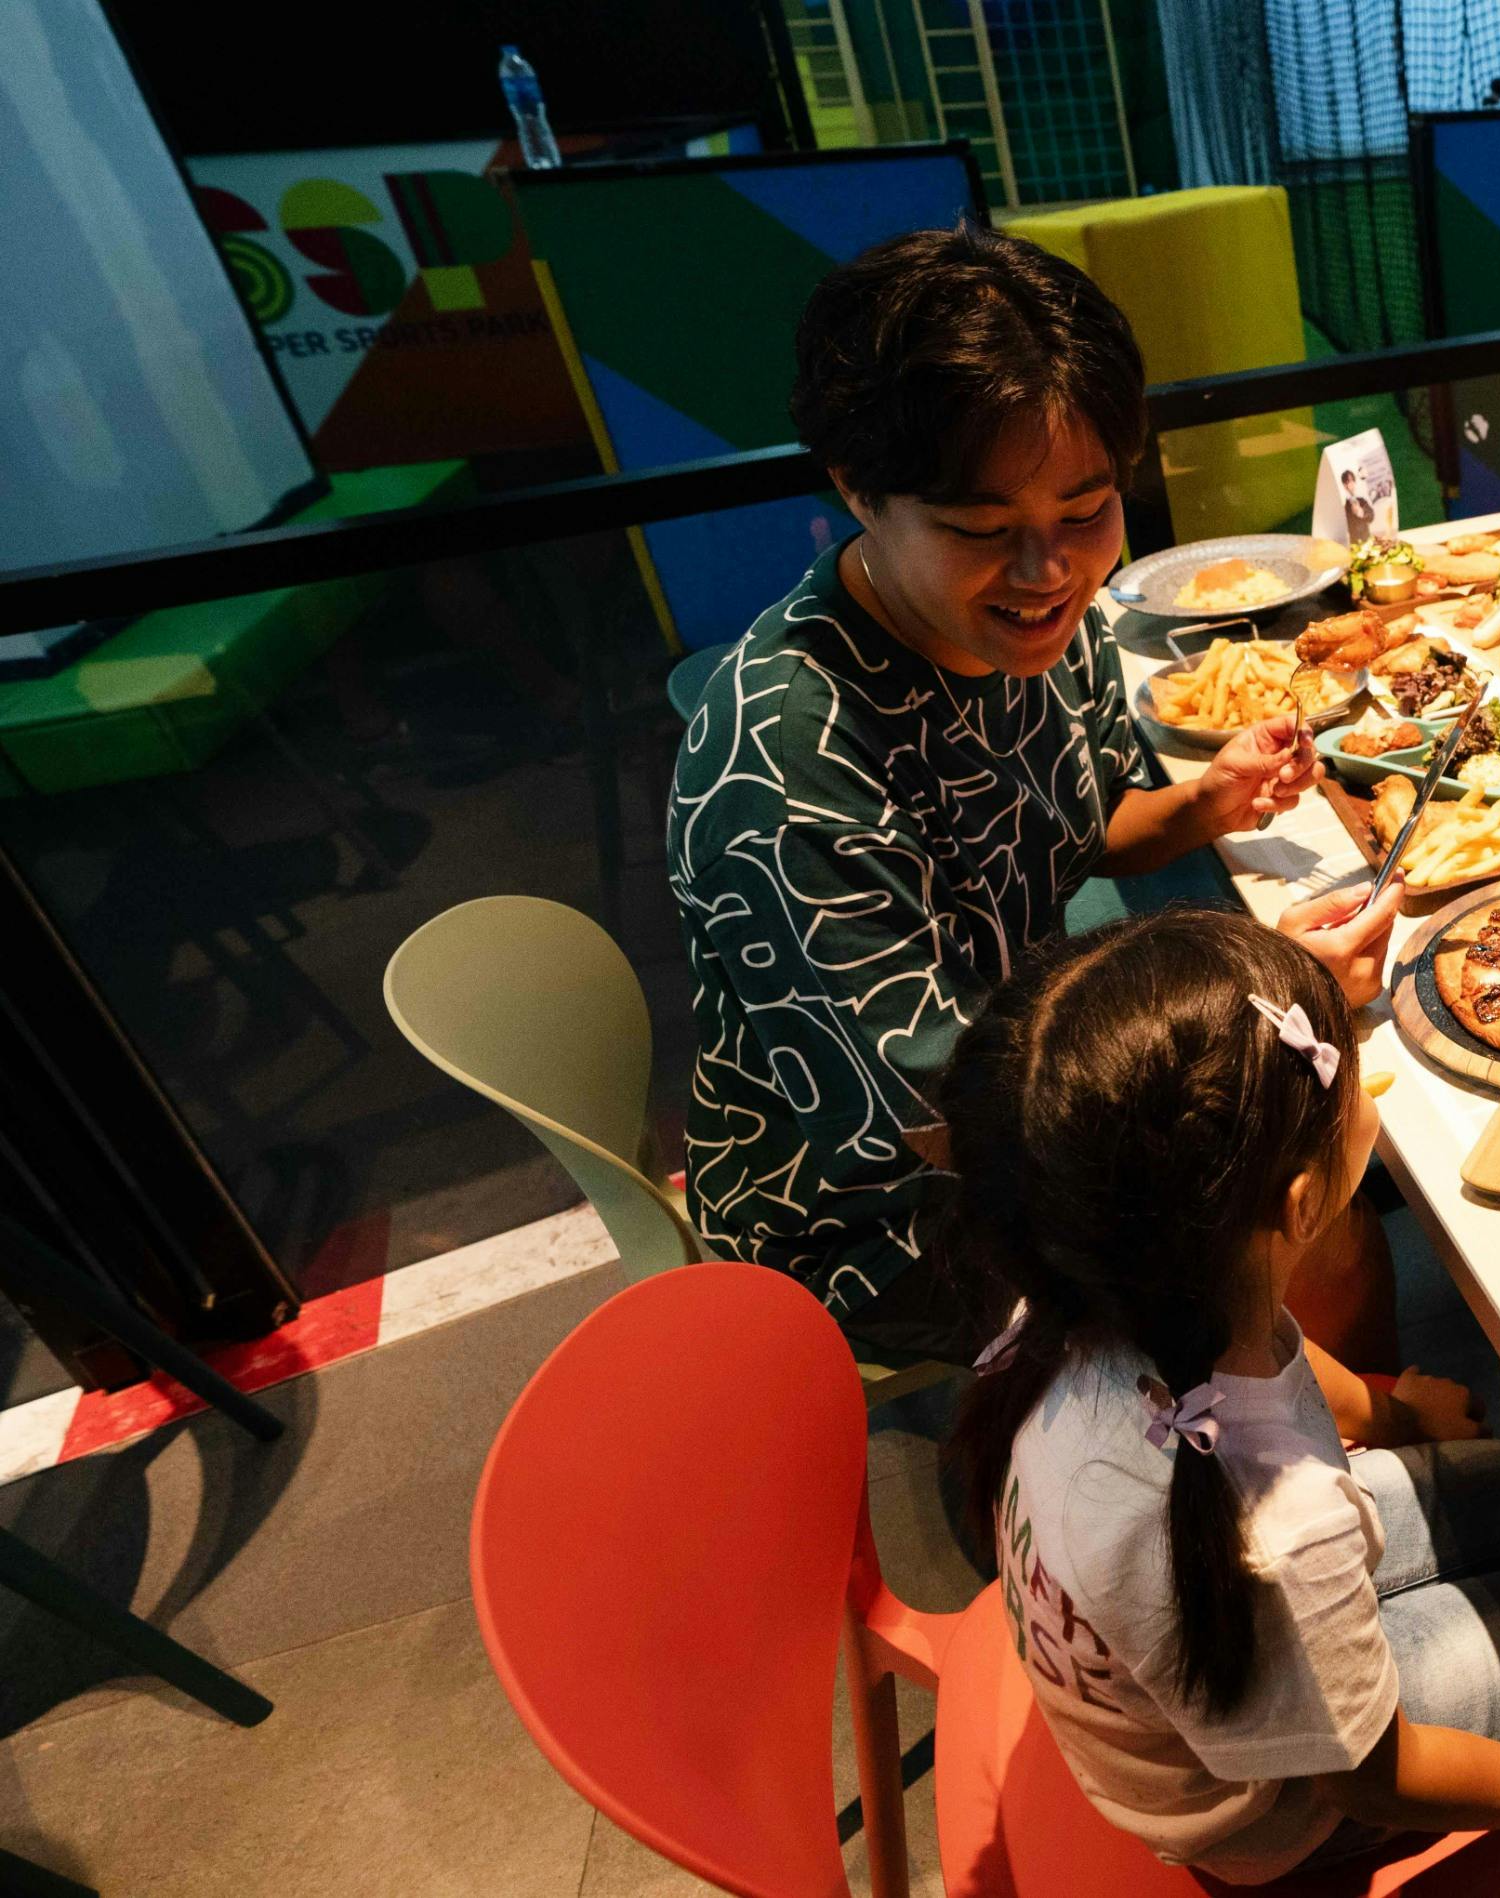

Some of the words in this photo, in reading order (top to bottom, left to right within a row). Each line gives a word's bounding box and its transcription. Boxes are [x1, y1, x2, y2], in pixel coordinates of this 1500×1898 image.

[263, 329, 330, 358] PER
[335, 318, 458, 352] SPORTS
[467, 308, 553, 339] PARK
